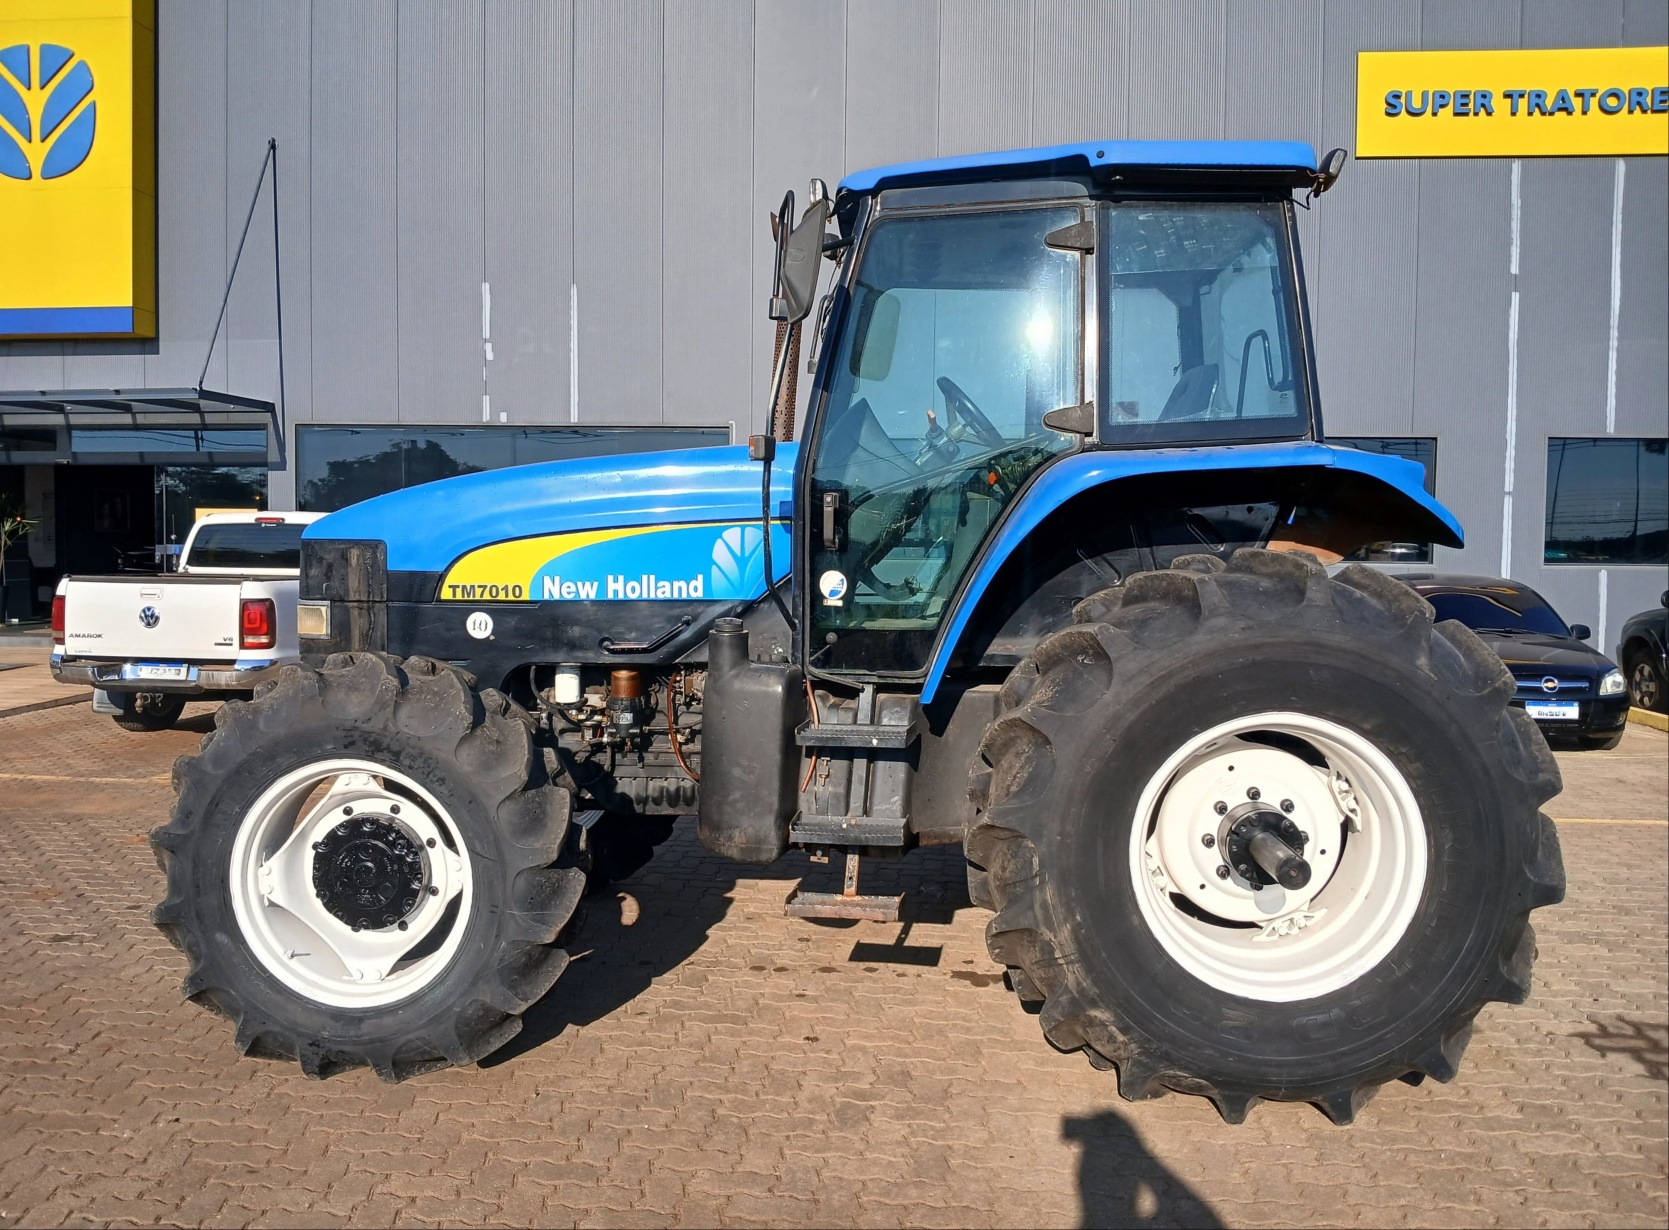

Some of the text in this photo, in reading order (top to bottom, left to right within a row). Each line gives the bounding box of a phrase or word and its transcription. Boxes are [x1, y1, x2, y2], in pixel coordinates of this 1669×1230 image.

[1385, 86, 1669, 118] SUPER TRATORE
[448, 584, 523, 599] TM7010
[543, 574, 704, 600] New Holland
